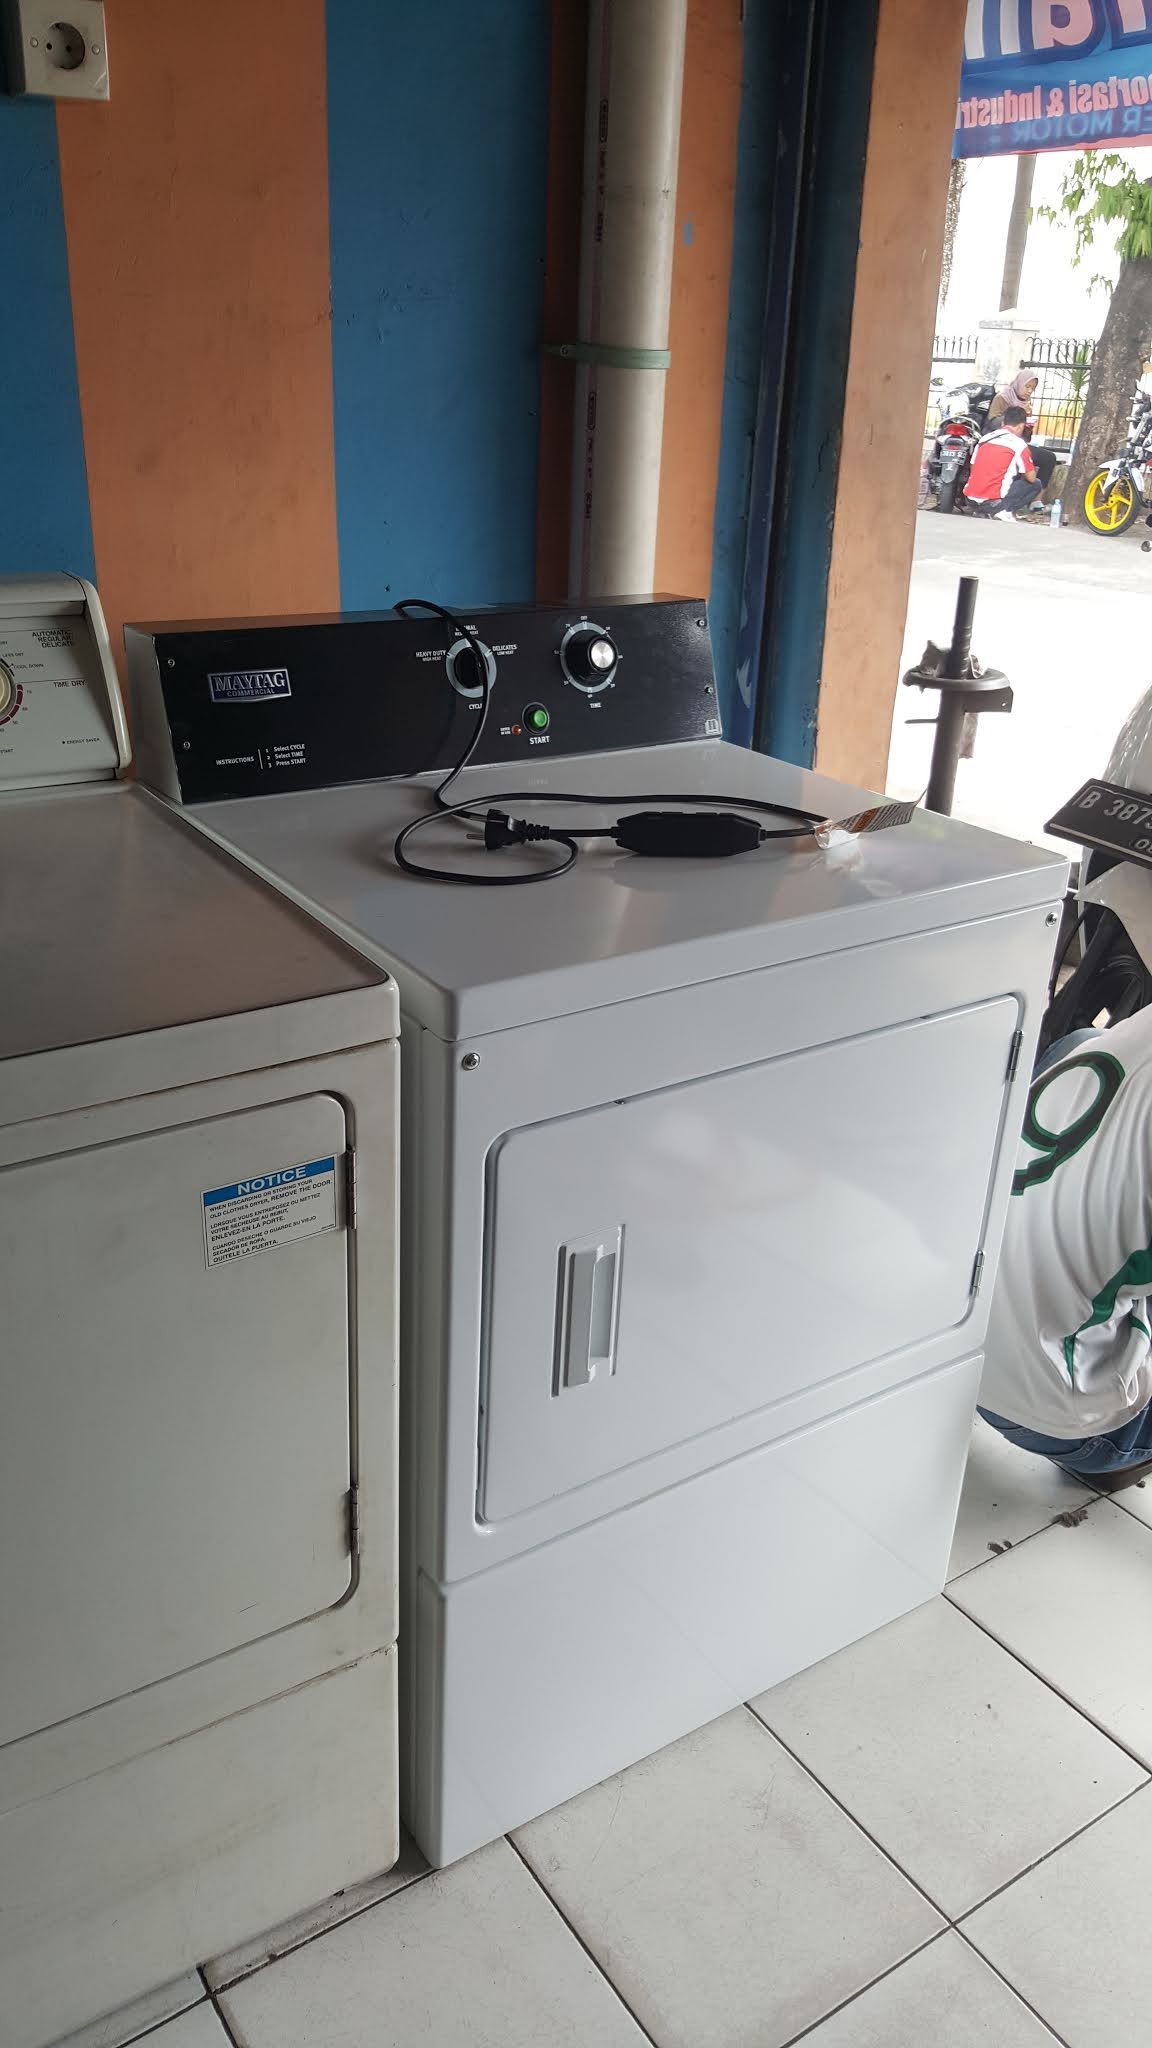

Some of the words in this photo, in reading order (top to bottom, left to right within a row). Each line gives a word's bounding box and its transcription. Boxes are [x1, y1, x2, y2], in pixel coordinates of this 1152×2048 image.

[213, 672, 286, 692] MAYTAG
[227, 688, 275, 697] COMMERCIAL
[529, 736, 550, 744] START
[216, 756, 254, 765] INSTRUCTIONS
[1078, 791, 1102, 808] B
[237, 1166, 307, 1195] NOTICE
[222, 1205, 249, 1216] CLOTHES
[271, 1190, 298, 1201] REMOVE
[313, 1179, 333, 1190] DOOR.
[228, 1195, 262, 1208] DISCARDING
[272, 1184, 296, 1194] STORING
[210, 1218, 237, 1229] LORSQUE
[238, 1212, 254, 1221] VOUS
[254, 1202, 290, 1216] ENTREPOSEZ
[300, 1192, 321, 1204] METTEZ
[210, 1225, 229, 1235] VOTRE
[230, 1216, 260, 1229] SECHEUSE
[211, 1226, 251, 1242] ENLEVEZ-EN
[252, 1222, 260, 1230] LA
[262, 1216, 286, 1226] PORTE.
[212, 1239, 236, 1250] CUANDO
[237, 1232, 263, 1243] DESECHE
[270, 1223, 292, 1233] GUARDE
[301, 1215, 317, 1224] VIEJO
[212, 1244, 240, 1256] SECADOR
[213, 1250, 240, 1263] QUITELE
[252, 1240, 278, 1251] PUERTA.
